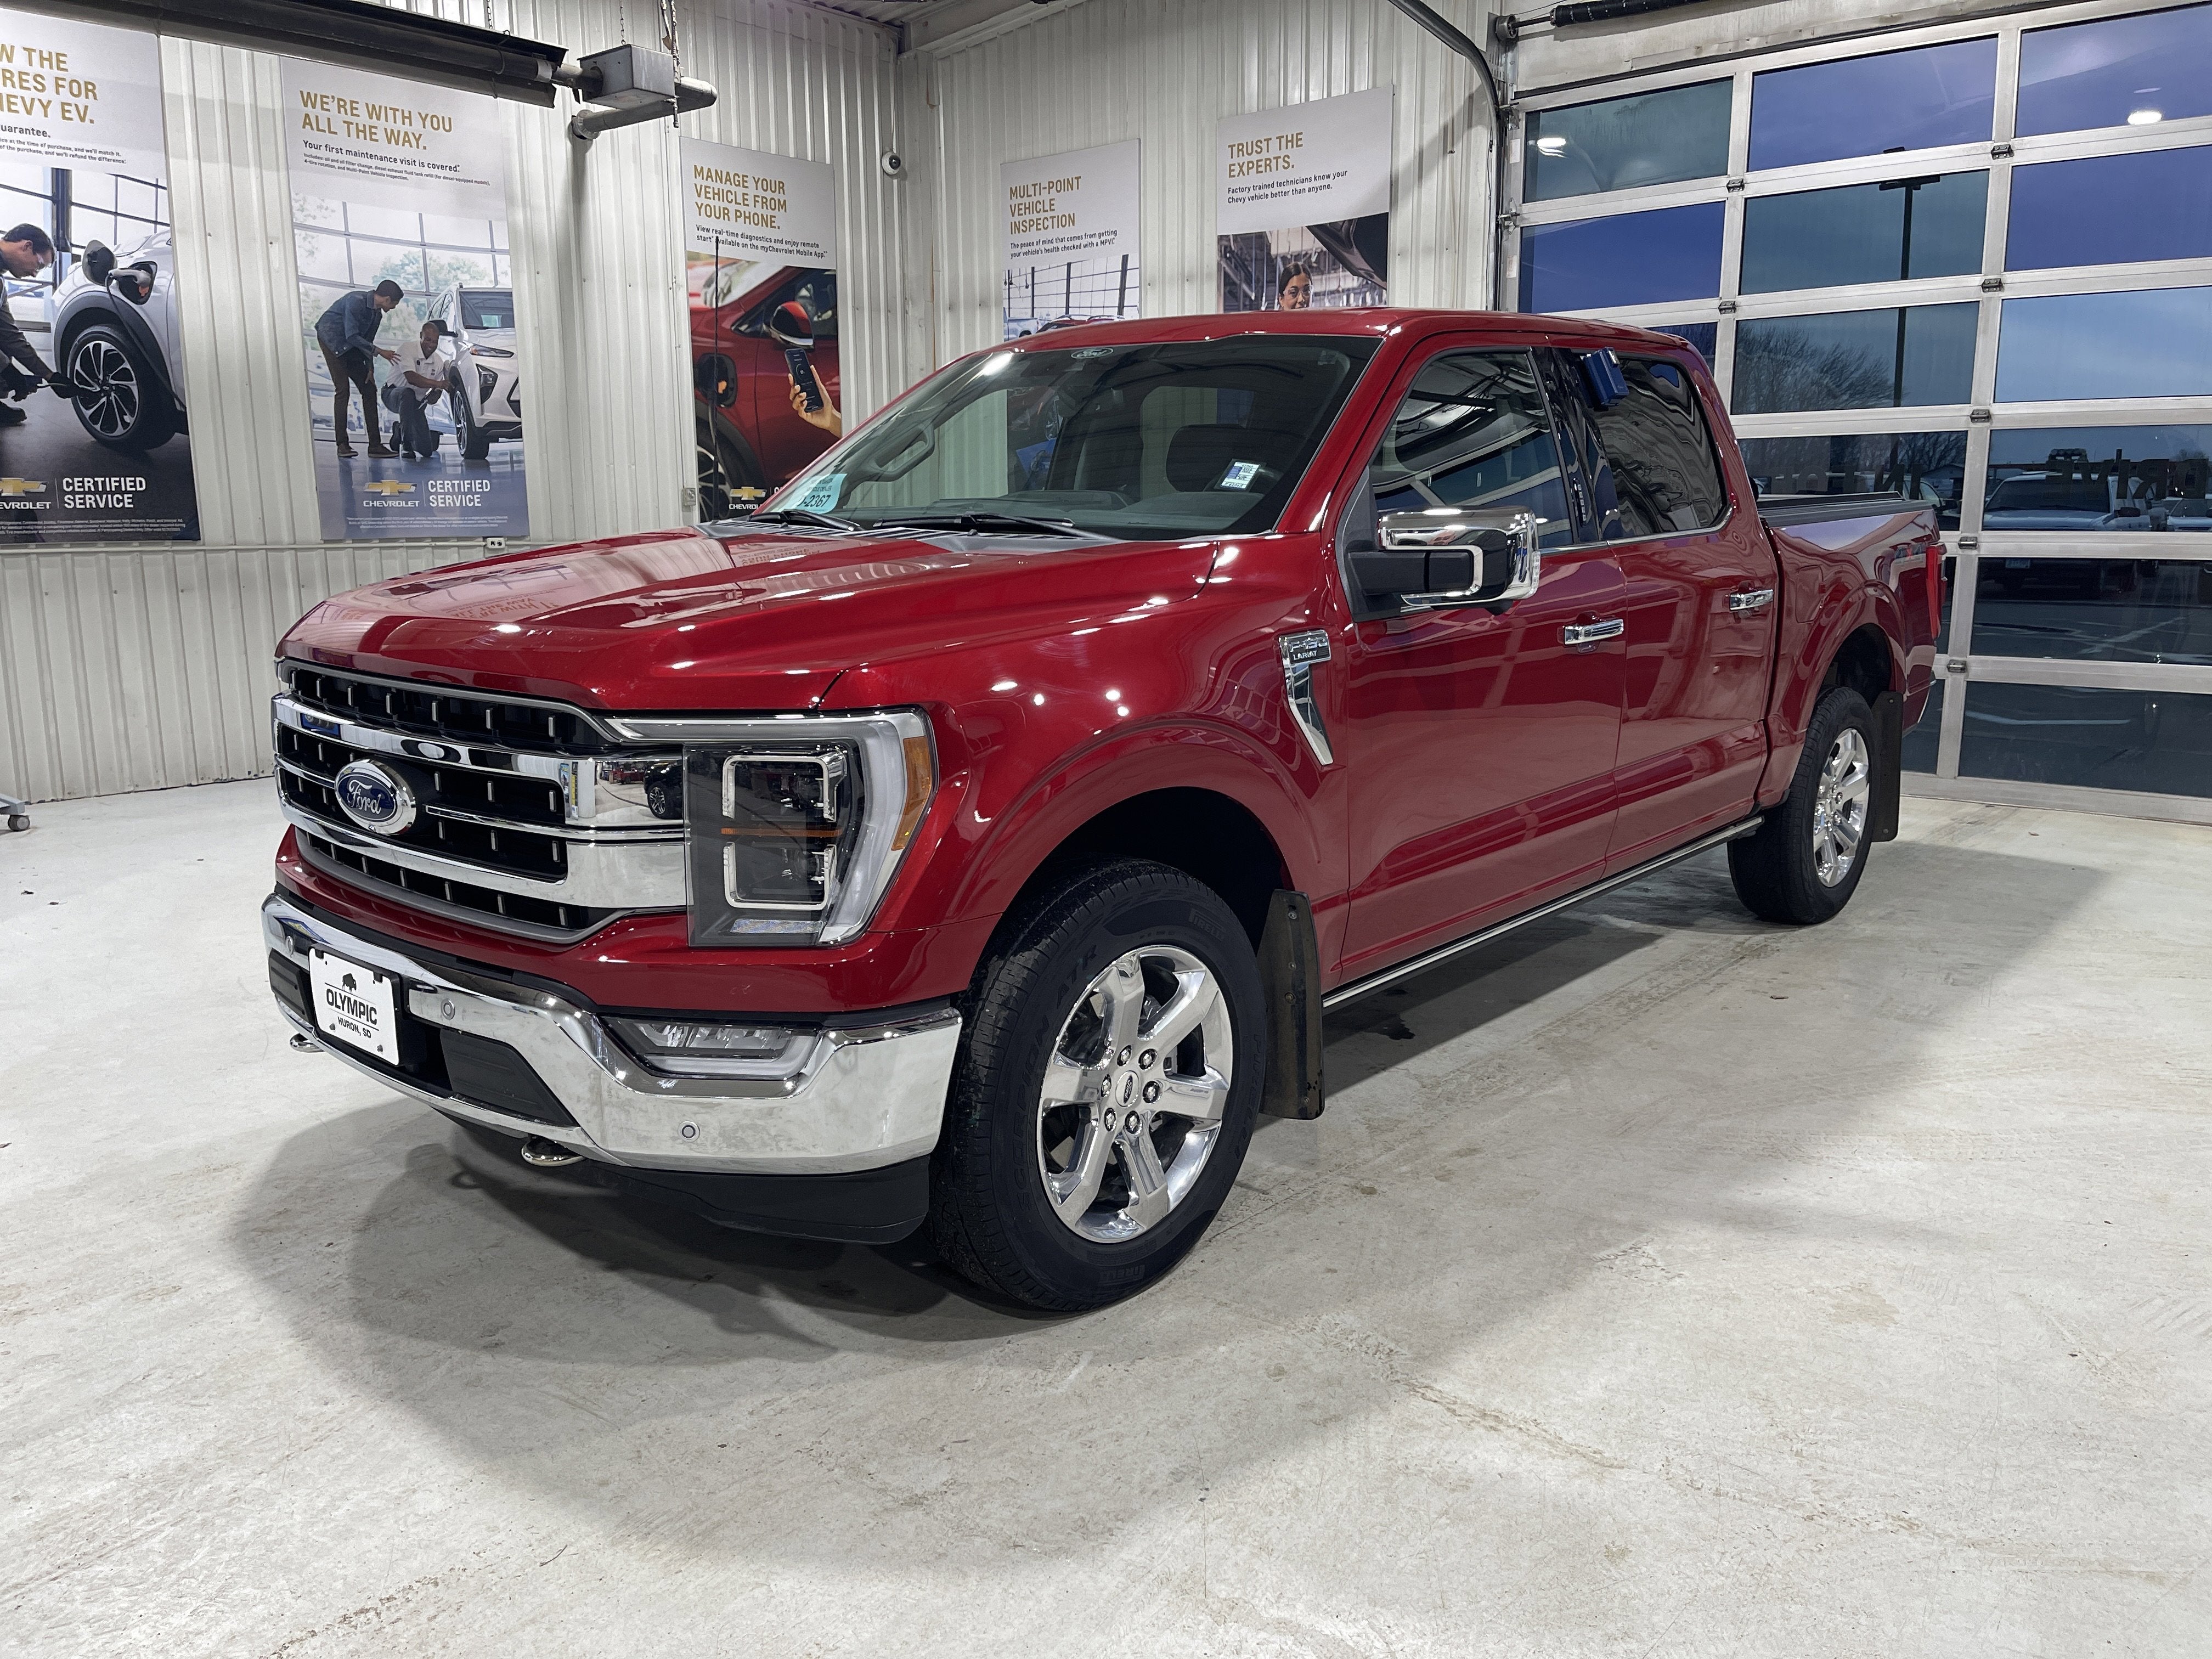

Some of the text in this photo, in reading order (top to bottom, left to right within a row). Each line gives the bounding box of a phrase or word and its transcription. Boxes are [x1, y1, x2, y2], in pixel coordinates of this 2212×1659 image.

[23, 47, 69, 72] THE
[1, 69, 98, 101] RES FOR
[61, 101, 95, 125] EV.
[300, 90, 453, 133] WE'RE WITH YOU
[301, 113, 427, 150] ALL THE WAY.
[47, 144, 74, 152] purchase,
[302, 139, 323, 150] Your
[325, 144, 343, 155] first
[346, 149, 398, 163] maintenance
[399, 156, 417, 167] visit
[419, 159, 425, 168] is
[1228, 132, 1304, 159] TRUST THE
[1228, 154, 1295, 178] EXPERTS.
[693, 165, 786, 195] MANAGE YOUR
[1009, 176, 1081, 200] MULTI-POINT
[1228, 170, 1348, 194] Factory trained technicians know your
[693, 183, 787, 213] VEHICLE FROM
[1228, 183, 1333, 204] Chevy vehicle better than anyone.
[695, 201, 781, 229] YOUR PHONE.
[1009, 198, 1056, 217] VEHICLE
[1010, 212, 1075, 235] INSPECTION
[696, 224, 710, 233] View
[712, 228, 739, 238] real-time
[740, 232, 772, 243] diagnostics
[785, 239, 799, 247] enjoy
[1020, 242, 1034, 250] peace
[1042, 237, 1054, 245] mind
[1066, 234, 1083, 242] comes
[1098, 229, 1117, 239] getting
[760, 245, 795, 255] myChevrolet
[795, 249, 813, 257] Mobile
[1010, 251, 1021, 259] your
[1044, 245, 1060, 254] health
[1060, 242, 1082, 252] checked
[63, 477, 146, 492] CERTIFIED
[427, 479, 490, 493] CERTIFIED
[64, 494, 134, 509] SERVICE
[430, 494, 482, 507] SERVICE
[1293, 651, 1317, 661] LARIAT
[347, 780, 382, 815] Ford
[326, 989, 377, 1025] OLYMPIC
[337, 1016, 372, 1039] HURON, SD
[1124, 1079, 1132, 1099] Ford
